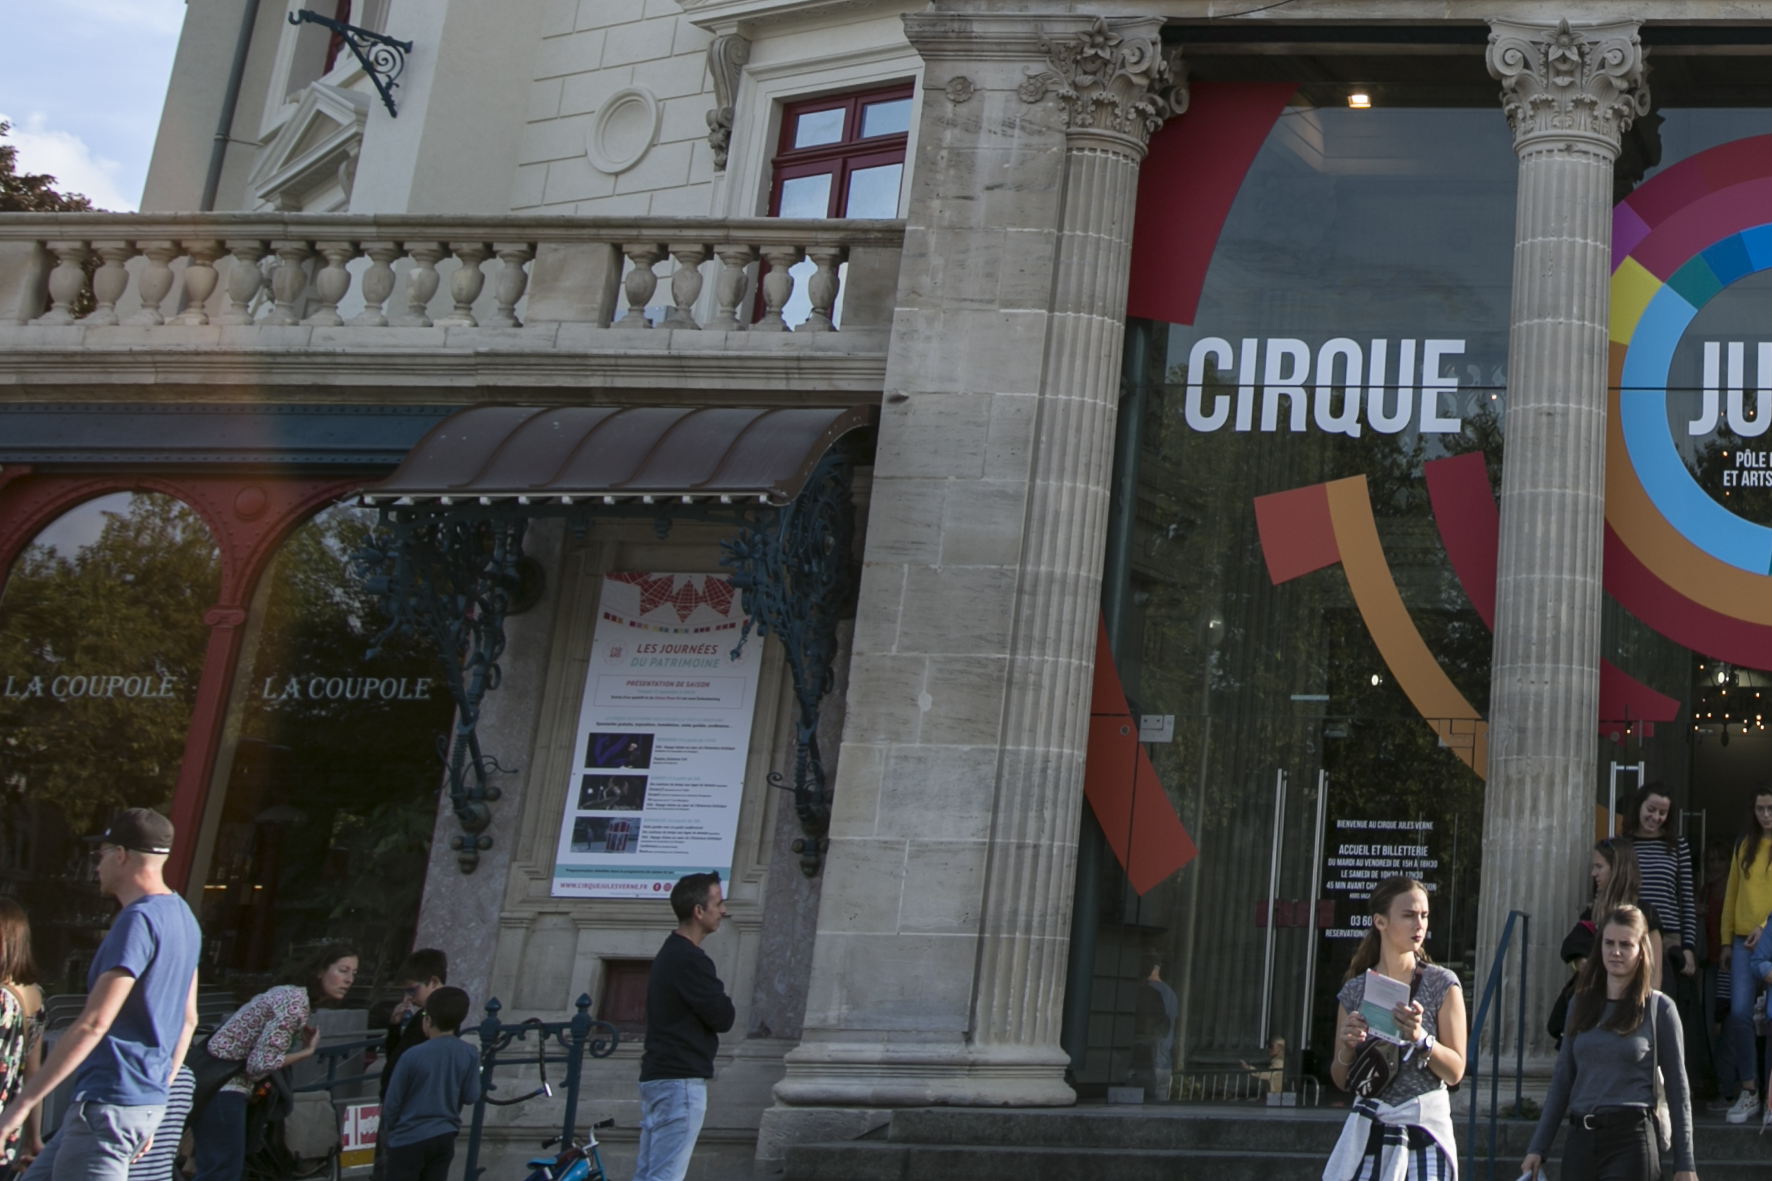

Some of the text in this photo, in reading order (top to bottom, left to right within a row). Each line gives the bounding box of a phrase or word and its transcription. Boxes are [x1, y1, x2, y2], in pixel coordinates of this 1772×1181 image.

[1185, 337, 1465, 437] CIRQUE
[1736, 448, 1767, 468] PÔLE
[1723, 470, 1738, 486] ET
[1741, 471, 1772, 487] ARTS
[637, 643, 719, 655] LES JOURNÉES
[630, 657, 720, 668] DU PATRIMOINE
[4, 675, 177, 701] LA COUPOLE
[262, 676, 432, 701] LA COUPOLE
[1336, 820, 1434, 830] BIENVENUE AU CIRQUE JULES VERNE
[1339, 844, 1429, 857] ACCUEIL ET BILLETTERIE
[1328, 858, 1438, 868] DU MARDI AU VENDREDI DE 15H À 18H30
[1341, 870, 1348, 878] LE
[1349, 870, 1370, 879] SAMEDI
[1370, 870, 1379, 879] DE
[1326, 881, 1334, 889] 45
[1334, 881, 1346, 889] MIN
[1347, 881, 1366, 889] AVANT
[1350, 915, 1373, 926] 03 60
